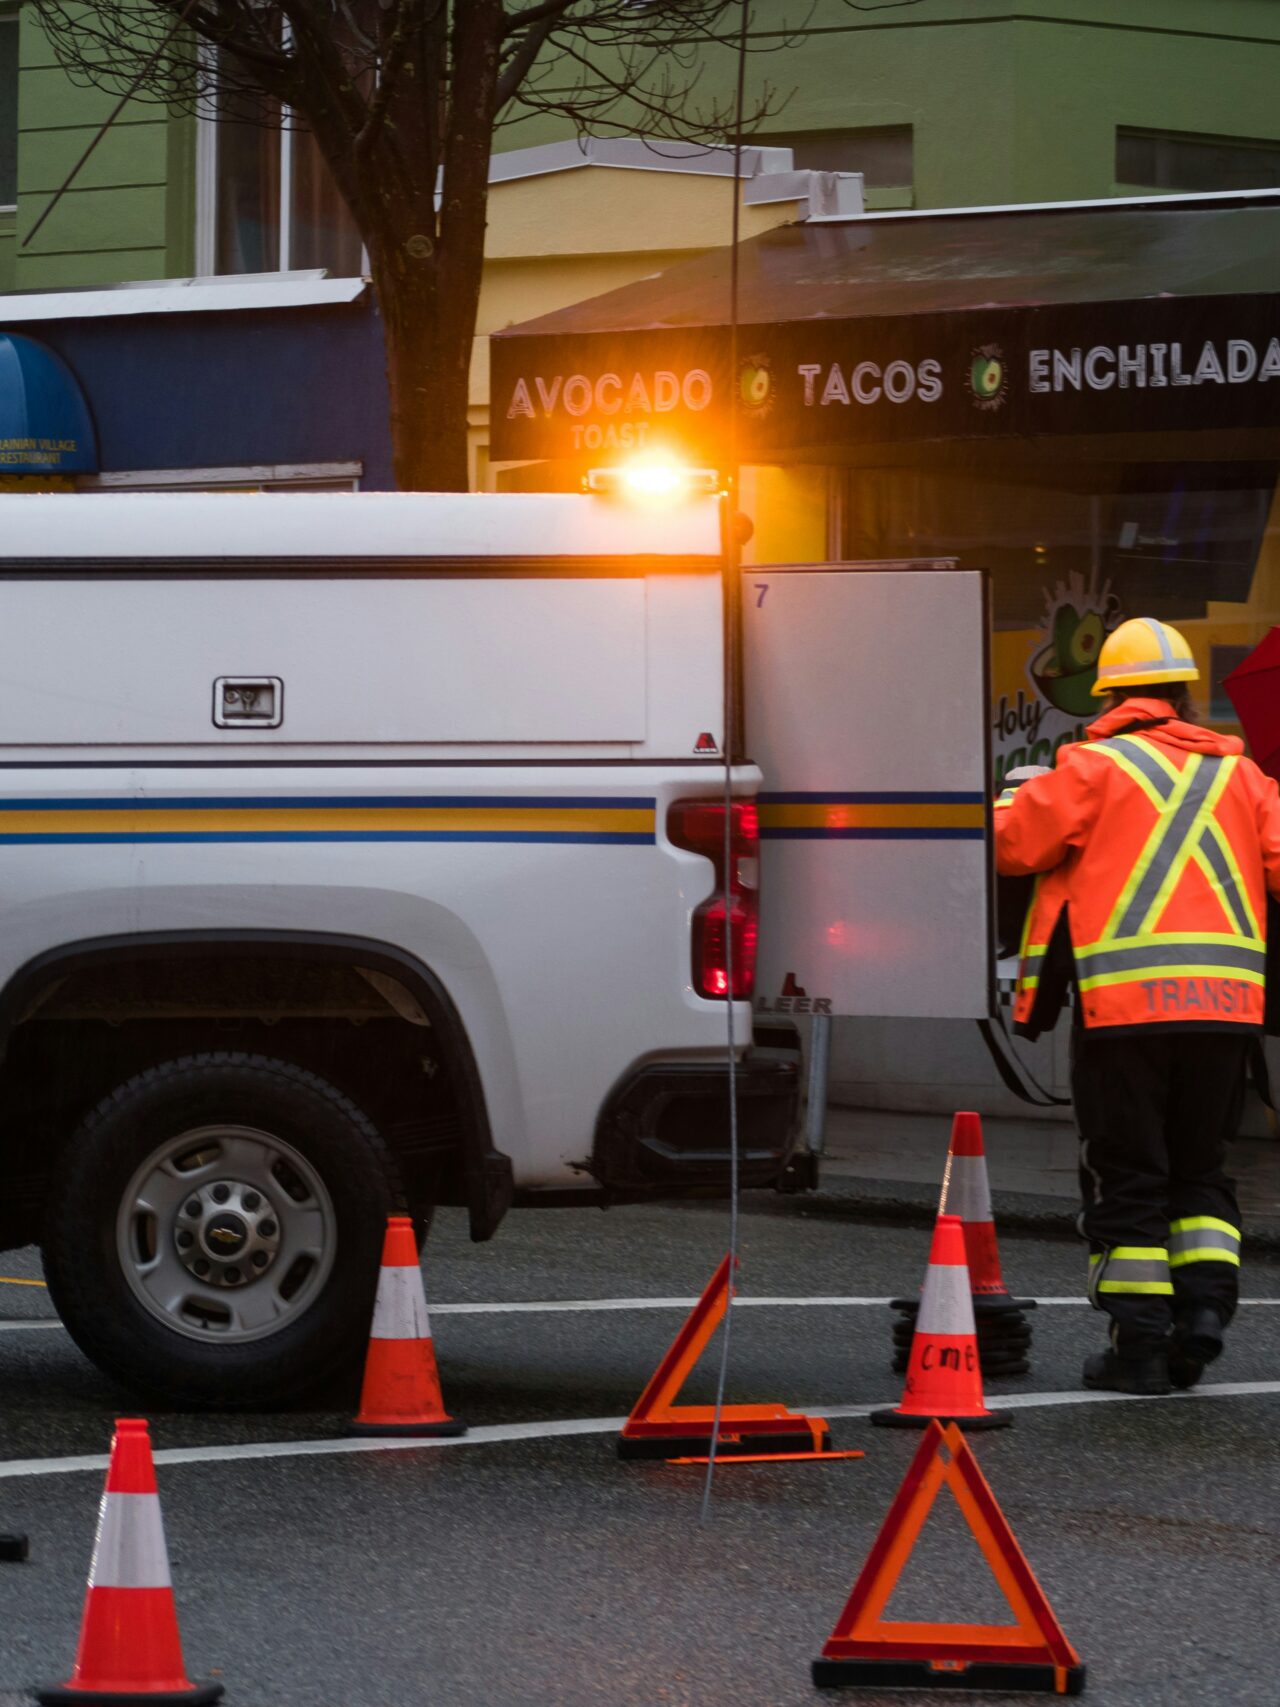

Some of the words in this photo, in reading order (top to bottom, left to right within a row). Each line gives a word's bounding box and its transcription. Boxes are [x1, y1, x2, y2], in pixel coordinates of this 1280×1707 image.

[507, 368, 713, 420] AVOCADO
[797, 358, 944, 407] TACOS
[0, 438, 37, 450] AINIAN
[39, 438, 78, 452] VILLAGE
[569, 421, 650, 450] TOAST
[754, 583, 770, 609] 7
[756, 996, 833, 1015] LEER
